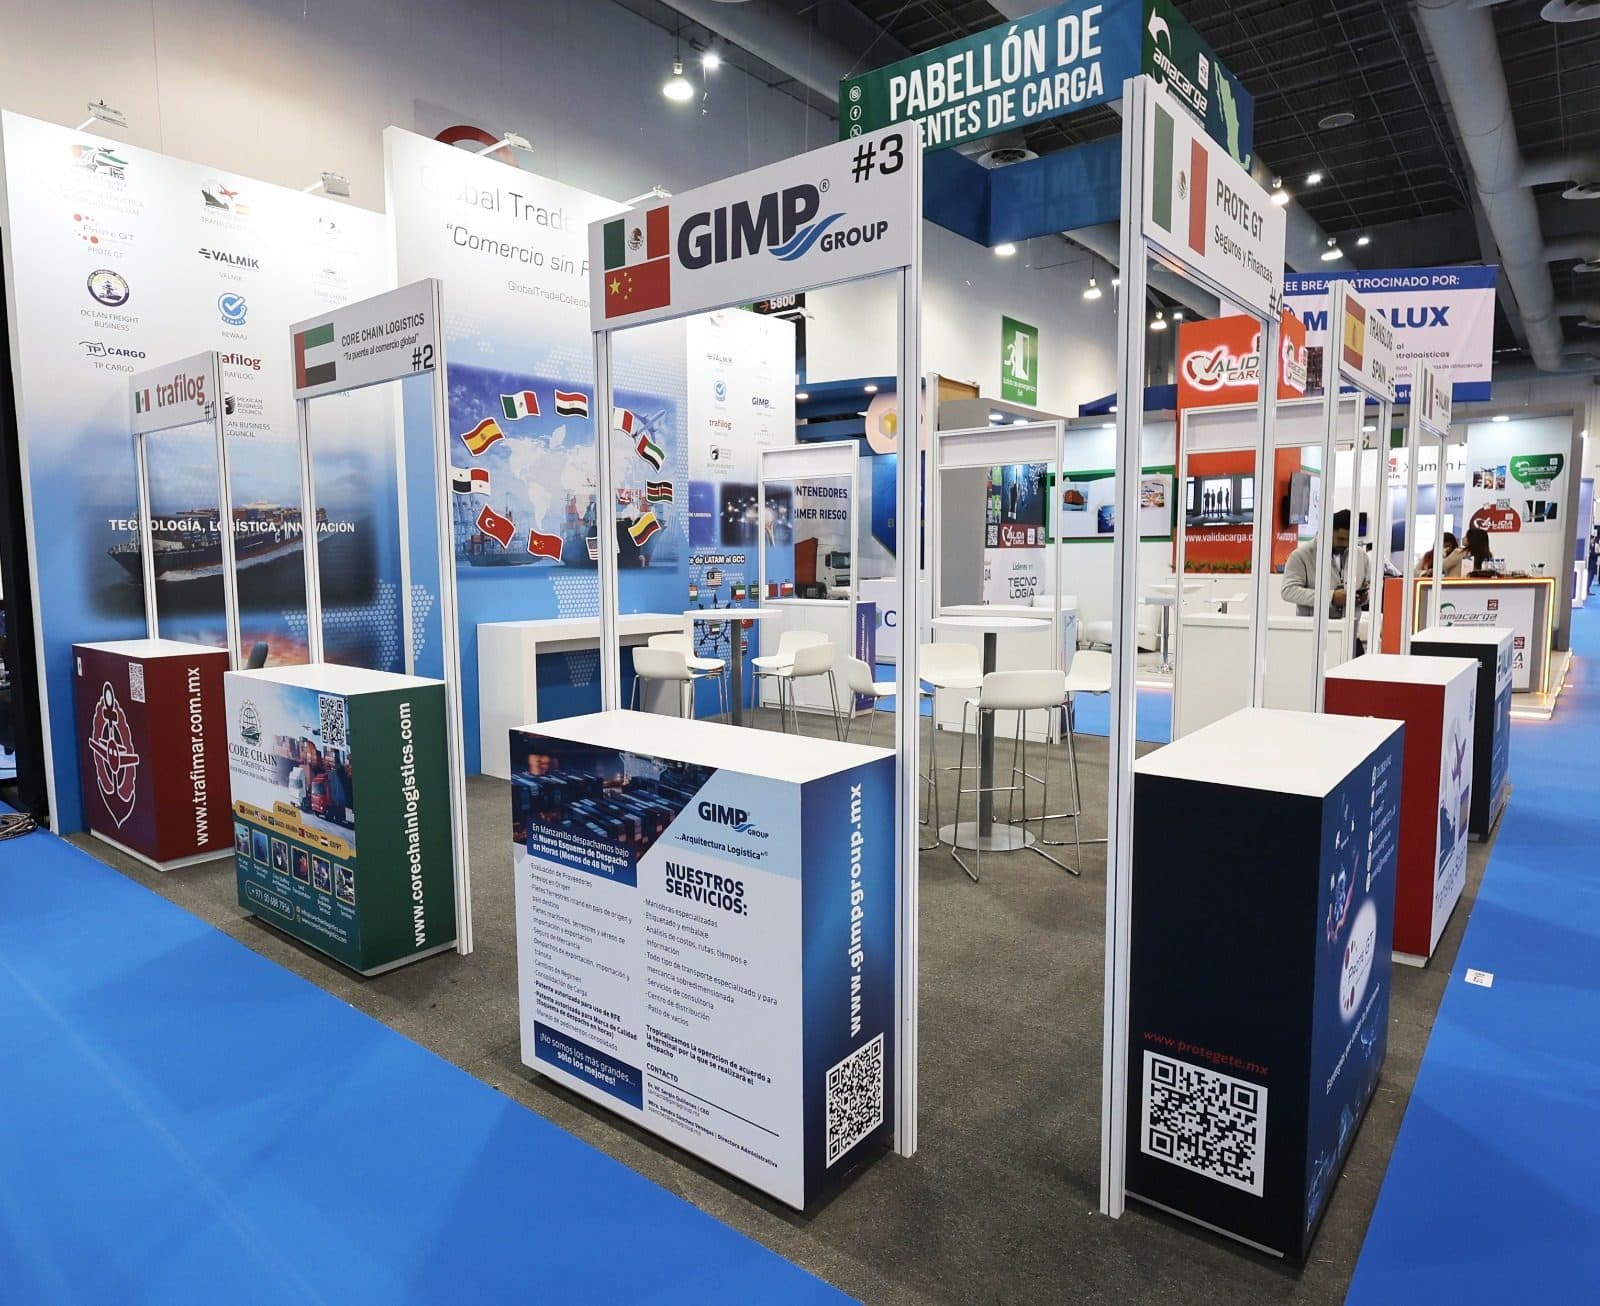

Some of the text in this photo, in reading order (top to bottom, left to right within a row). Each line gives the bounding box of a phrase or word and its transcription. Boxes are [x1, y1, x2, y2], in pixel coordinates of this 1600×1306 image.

[889, 5, 1102, 120] PABELLÓN DE
[1152, 46, 1208, 113] amacarga
[916, 62, 1104, 149] ENTES DE CARGA
[852, 134, 904, 183] #3
[1216, 178, 1264, 242] PROTE GT
[820, 220, 888, 252] GROUP
[211, 250, 260, 270] VALMIK
[550, 256, 574, 275] sin
[1214, 225, 1242, 256] Seguros
[1248, 250, 1272, 284] Finanzas
[1301, 275, 1460, 290] BREA ATROCINADO POR:
[80, 308, 140, 326] OCEAN FREIGHT
[770, 294, 796, 310] 5800
[94, 320, 130, 332] BUSINESS
[341, 312, 424, 347] CORE CHAIN LOGISTICS
[1369, 316, 1394, 350] TRANSLOG
[108, 348, 146, 360] CARGO
[222, 353, 262, 372] afilog
[351, 346, 368, 361] puente
[375, 338, 398, 352] comercio
[412, 342, 433, 371] #2
[105, 363, 134, 374] CARGO
[1372, 359, 1386, 384] SPAIN
[156, 374, 206, 409] trafilog
[243, 421, 270, 430] BUSINESS
[794, 486, 848, 499] NTENEDORES
[108, 518, 355, 534] TECOLOGÍA, LOÍSTICA, INNVACIÓN
[820, 509, 847, 521] RIESGO
[704, 555, 725, 564] LATAM
[732, 555, 745, 564] GCC
[1008, 576, 1038, 588] TECNO
[1440, 611, 1498, 621] amacarga
[187, 666, 208, 846] www.trafimar.com.mx
[228, 742, 276, 766] CORE CHAIN
[400, 702, 426, 947] www.corechainlogistics.com
[698, 799, 748, 830] GIMP
[532, 822, 629, 859] En Manzanillo despachamos bajo
[747, 828, 769, 840] GROUP
[533, 842, 614, 875] en Horas (Menos de 48 hrs)
[538, 834, 557, 847] Nuevo
[558, 840, 585, 857] Esquema
[586, 848, 595, 858] de
[595, 850, 628, 869] Despacho
[665, 860, 744, 899] NUESTROS
[665, 876, 748, 917] SERVICIOS:
[848, 783, 864, 1038] www.gimpgroup.mx
[551, 1036, 572, 1056] somos
[573, 1047, 584, 1061] los
[585, 1052, 598, 1068] más
[646, 1040, 673, 1059] despacho
[646, 1023, 771, 1085] Tropicalizamos la de acuerdo a
[646, 1032, 651, 1041] la
[652, 1034, 677, 1053] terminal
[678, 1046, 688, 1058] por
[689, 1051, 695, 1061] la
[696, 1054, 708, 1066] que
[709, 1059, 716, 1070] se
[747, 1076, 754, 1087] el
[557, 1049, 616, 1088] sólo los mejores!
[646, 1061, 678, 1083] CONTACTO
